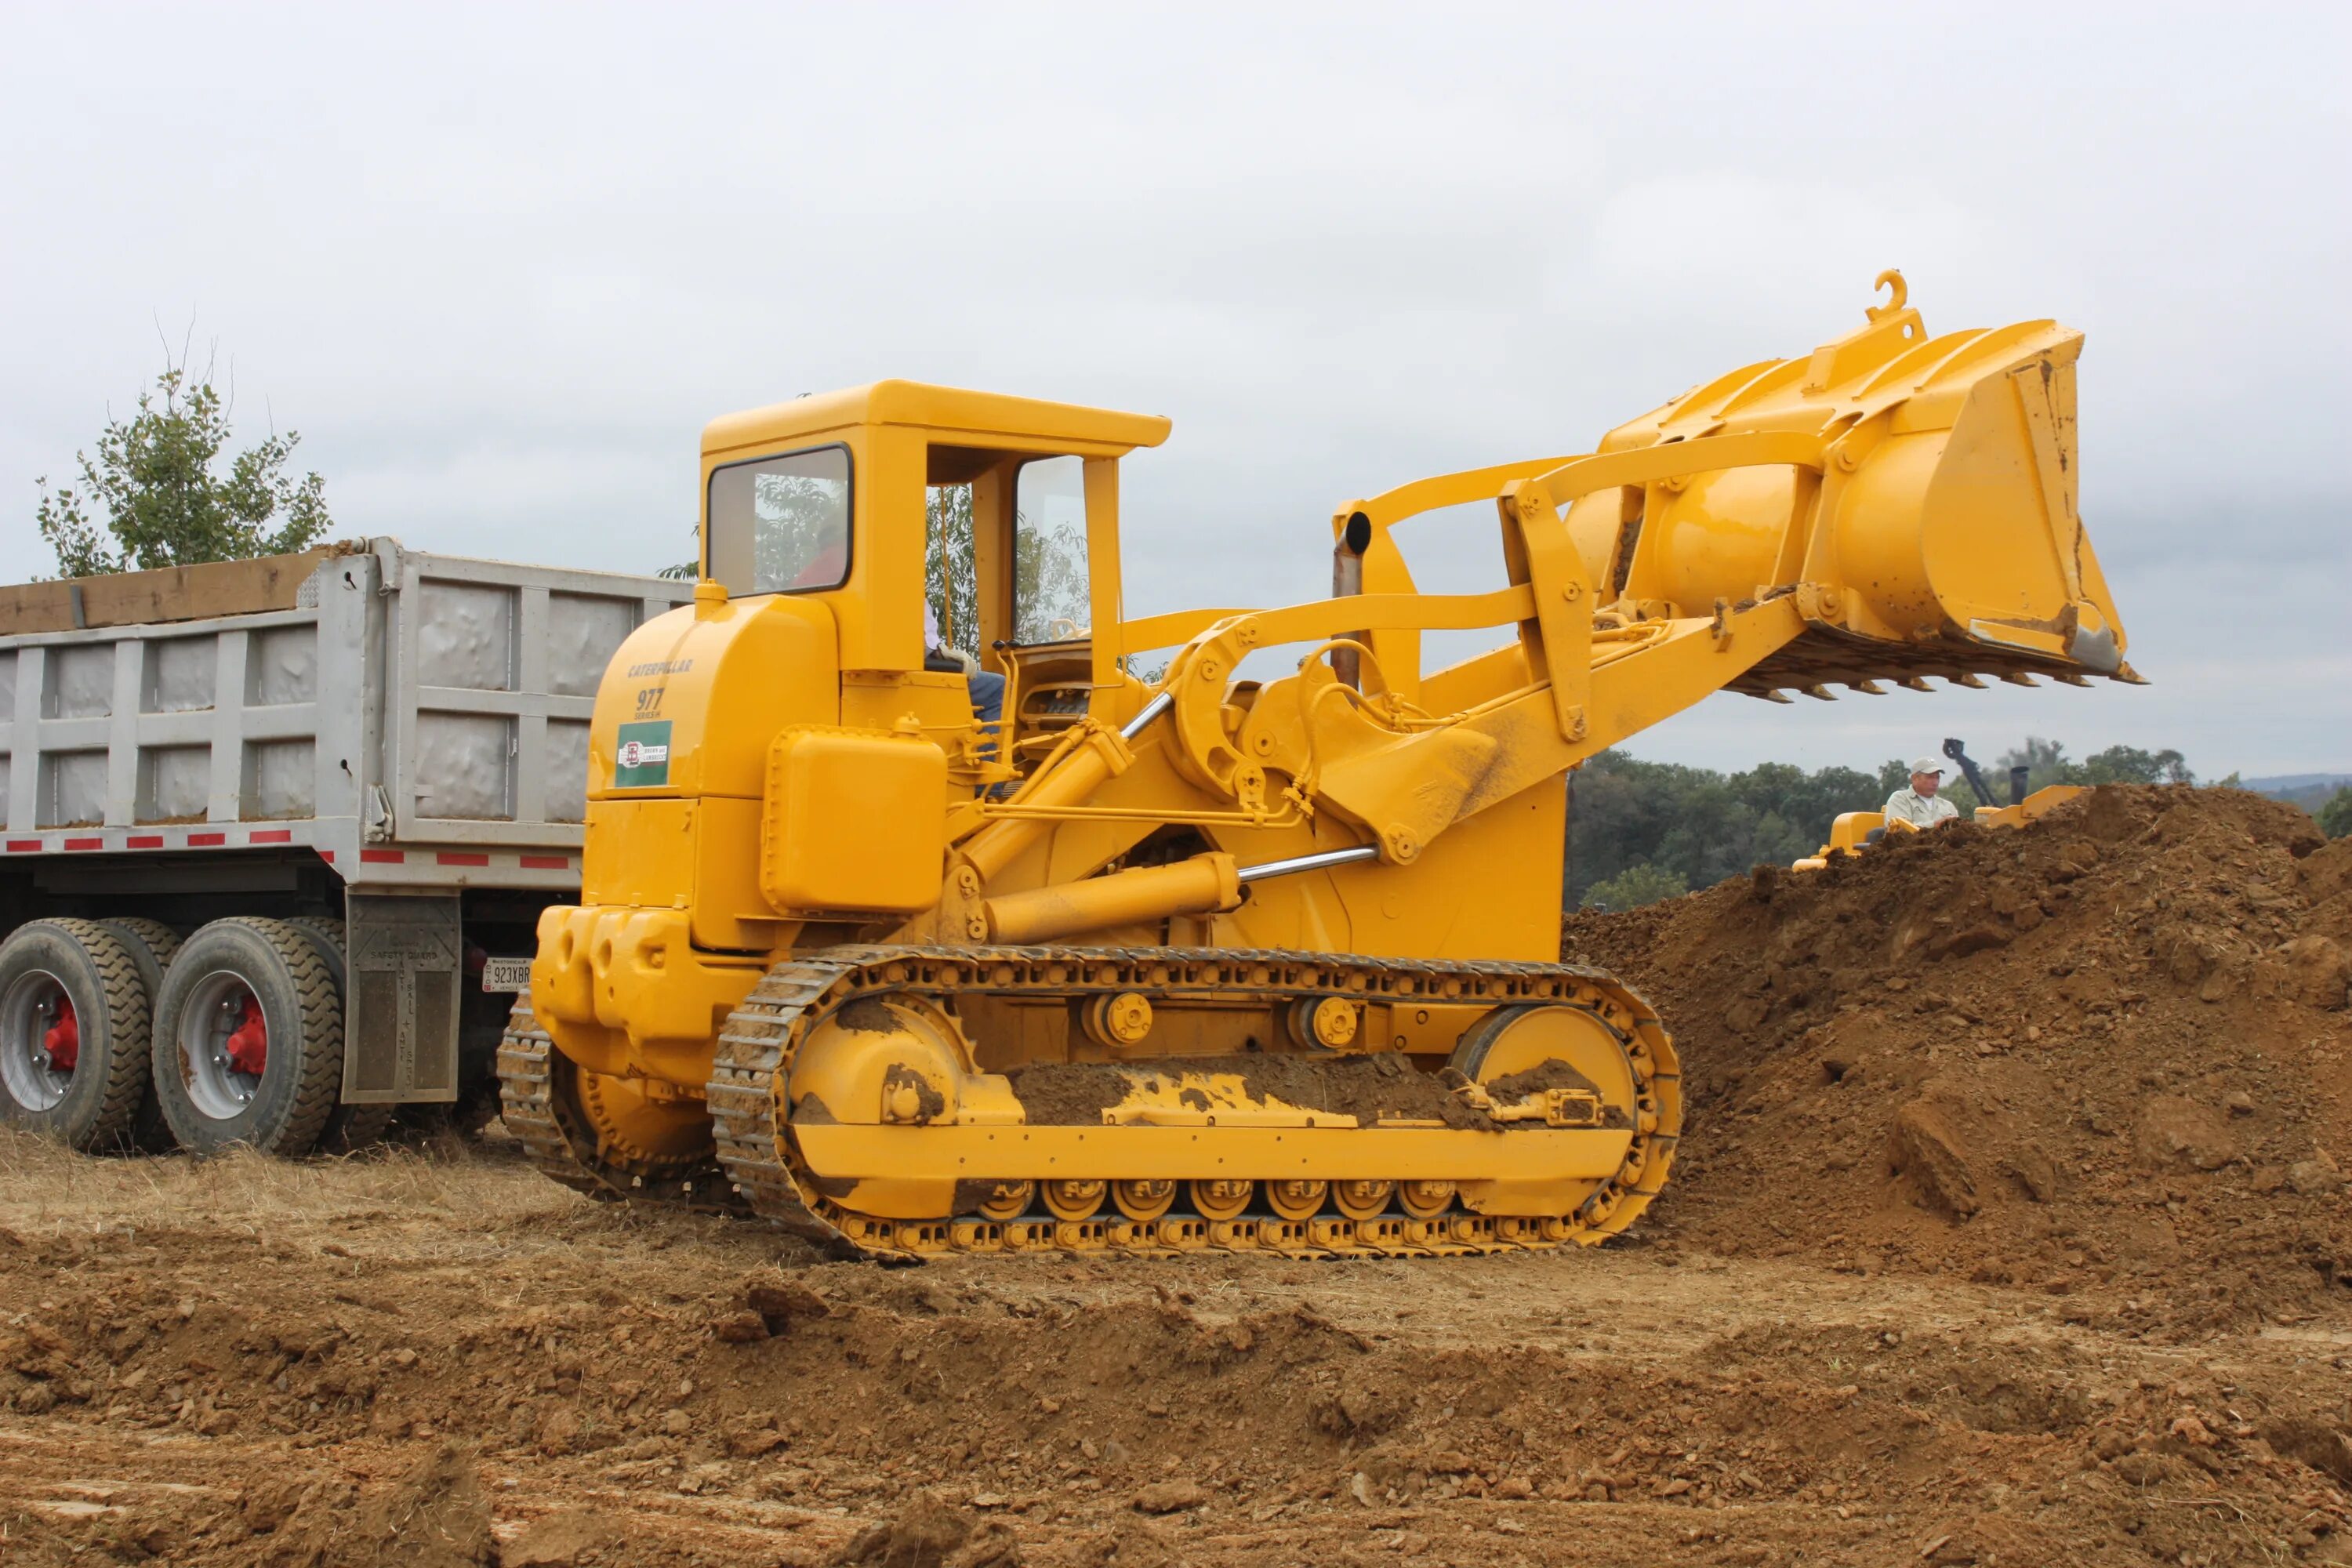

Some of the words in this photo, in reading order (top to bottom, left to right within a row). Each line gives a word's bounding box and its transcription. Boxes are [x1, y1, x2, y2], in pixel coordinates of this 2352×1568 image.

[628, 659, 693, 677] CATERPILLAR
[637, 688, 665, 711] 977
[408, 951, 437, 960] GUARD
[495, 967, 530, 983] 923XBR
